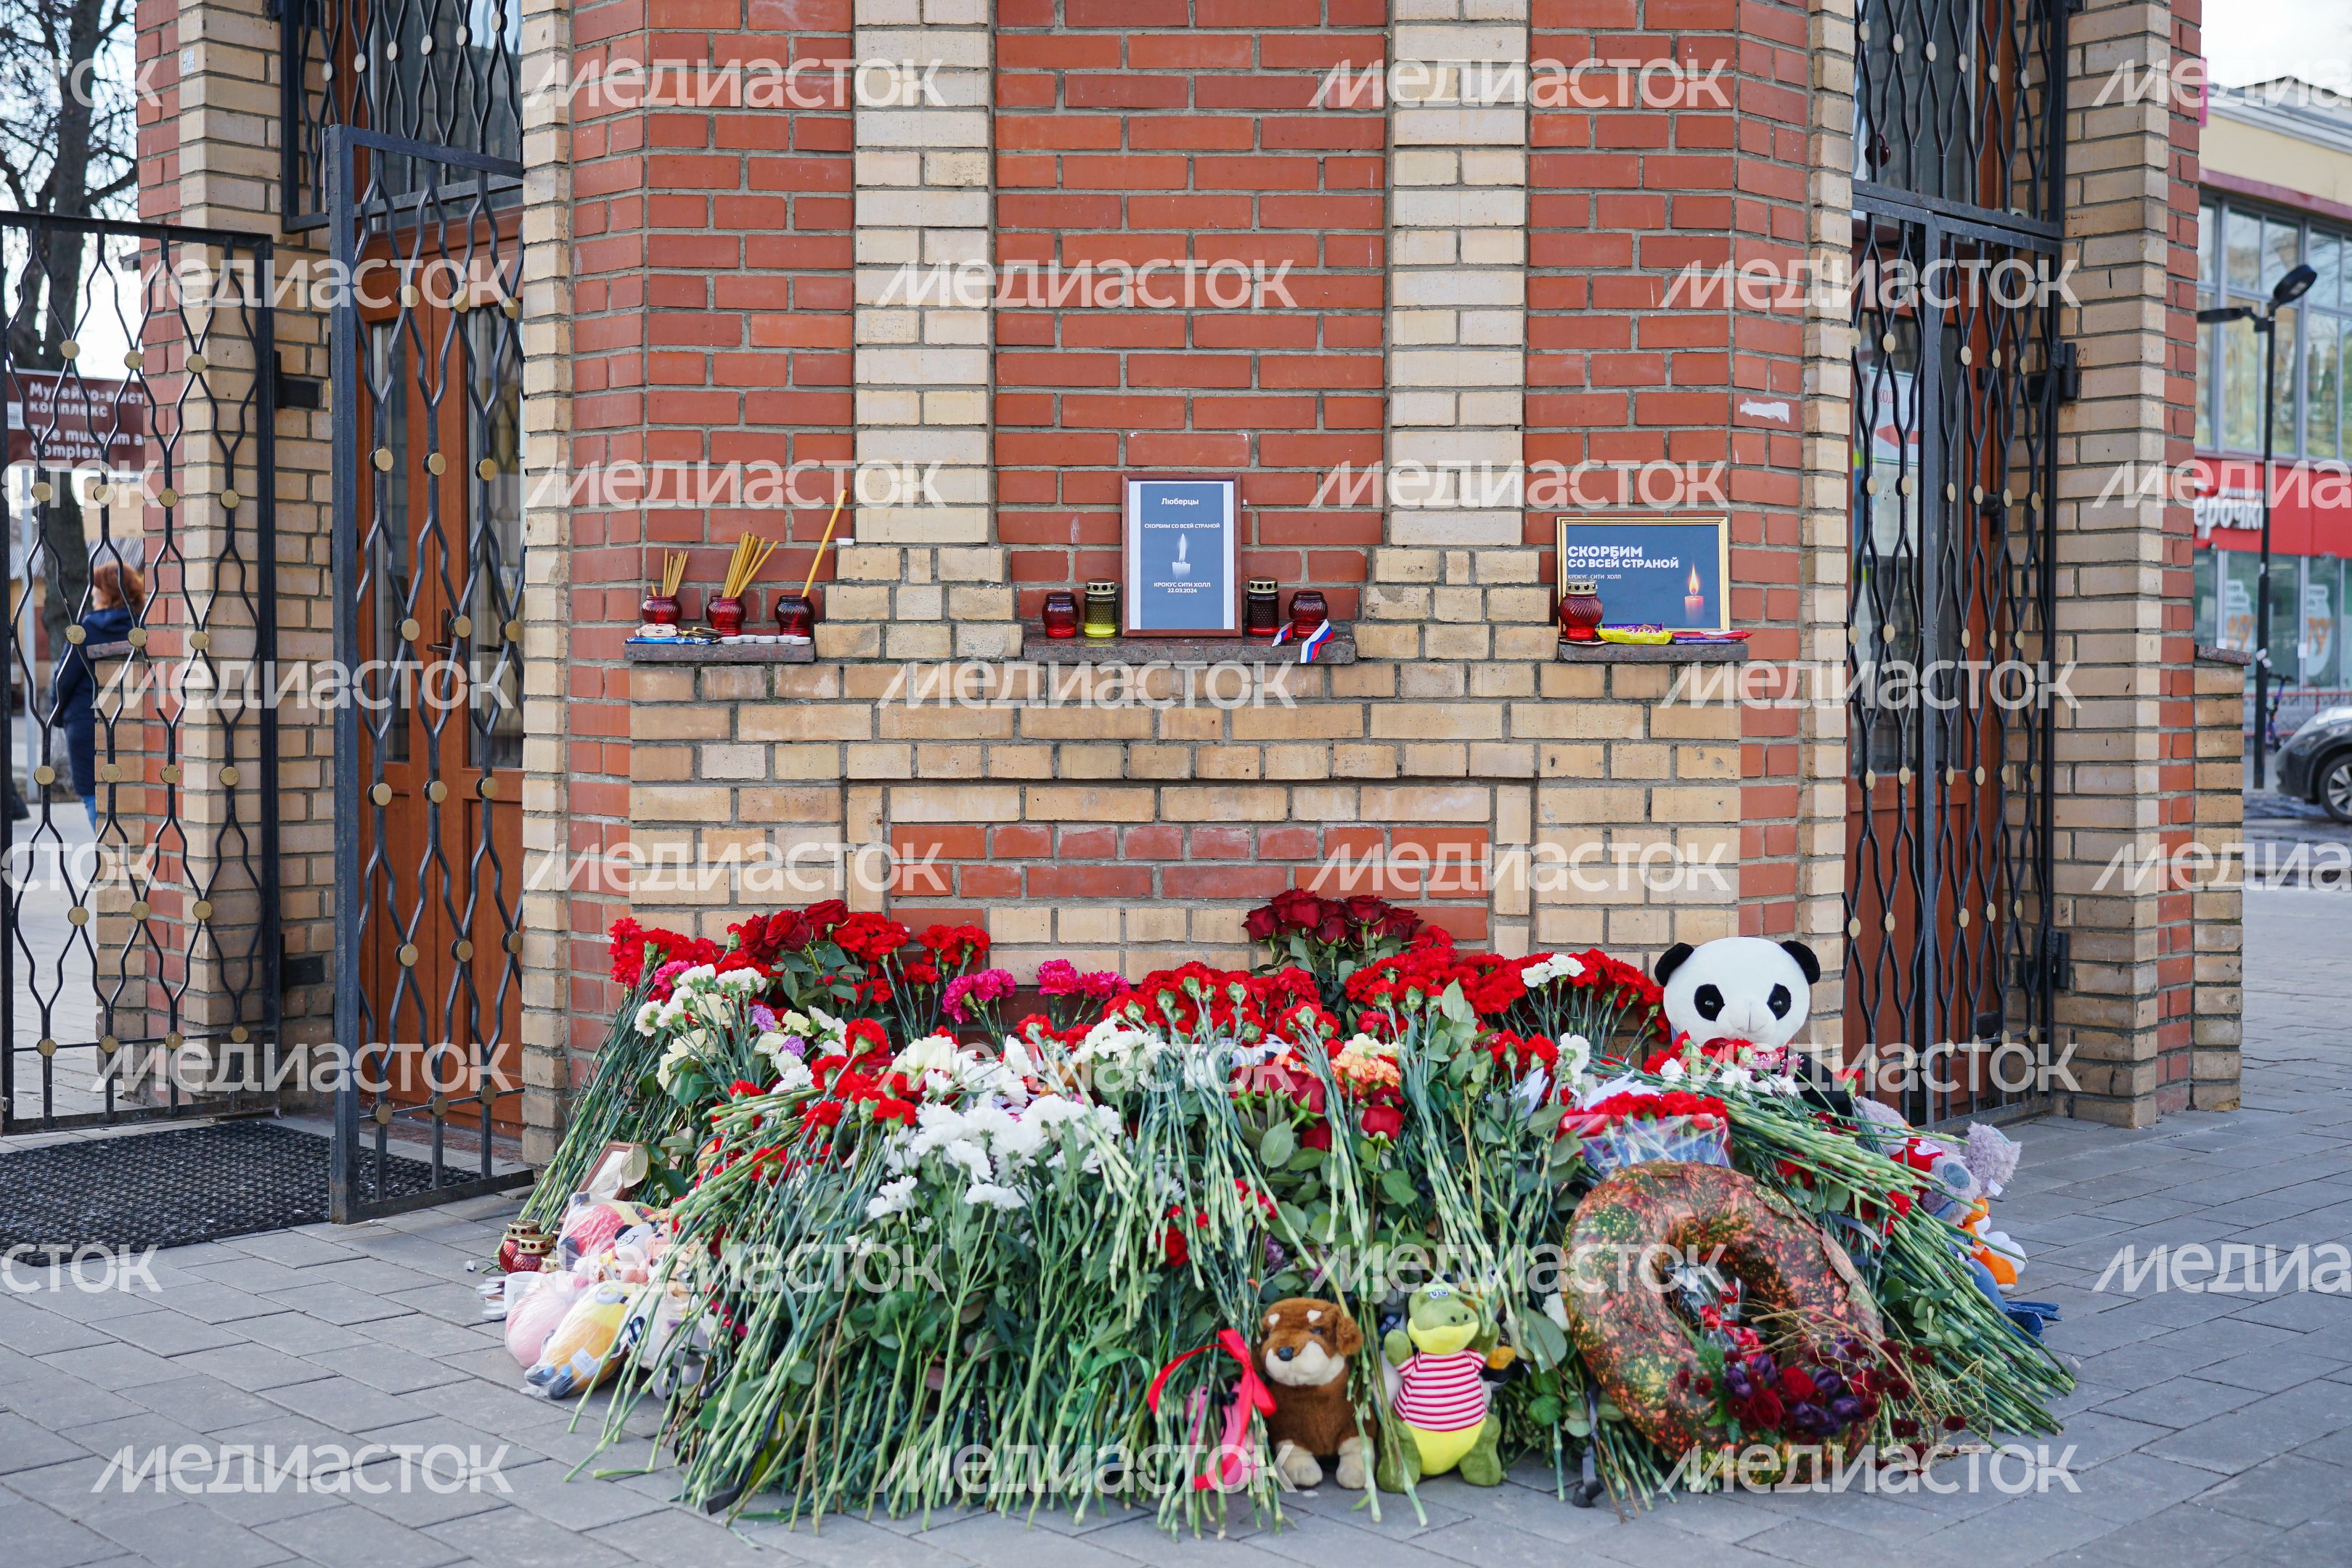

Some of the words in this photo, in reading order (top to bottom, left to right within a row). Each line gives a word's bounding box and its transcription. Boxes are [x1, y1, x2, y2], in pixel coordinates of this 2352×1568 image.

[1871, 388, 1894, 405] ХОД
[1161, 497, 1199, 507] Люберцы
[1567, 546, 1643, 558] СКОРБИМ
[1567, 559, 1586, 568] СО
[1588, 557, 1620, 568] ВСЕЙ
[1622, 557, 1679, 568] СТРАНОЙ
